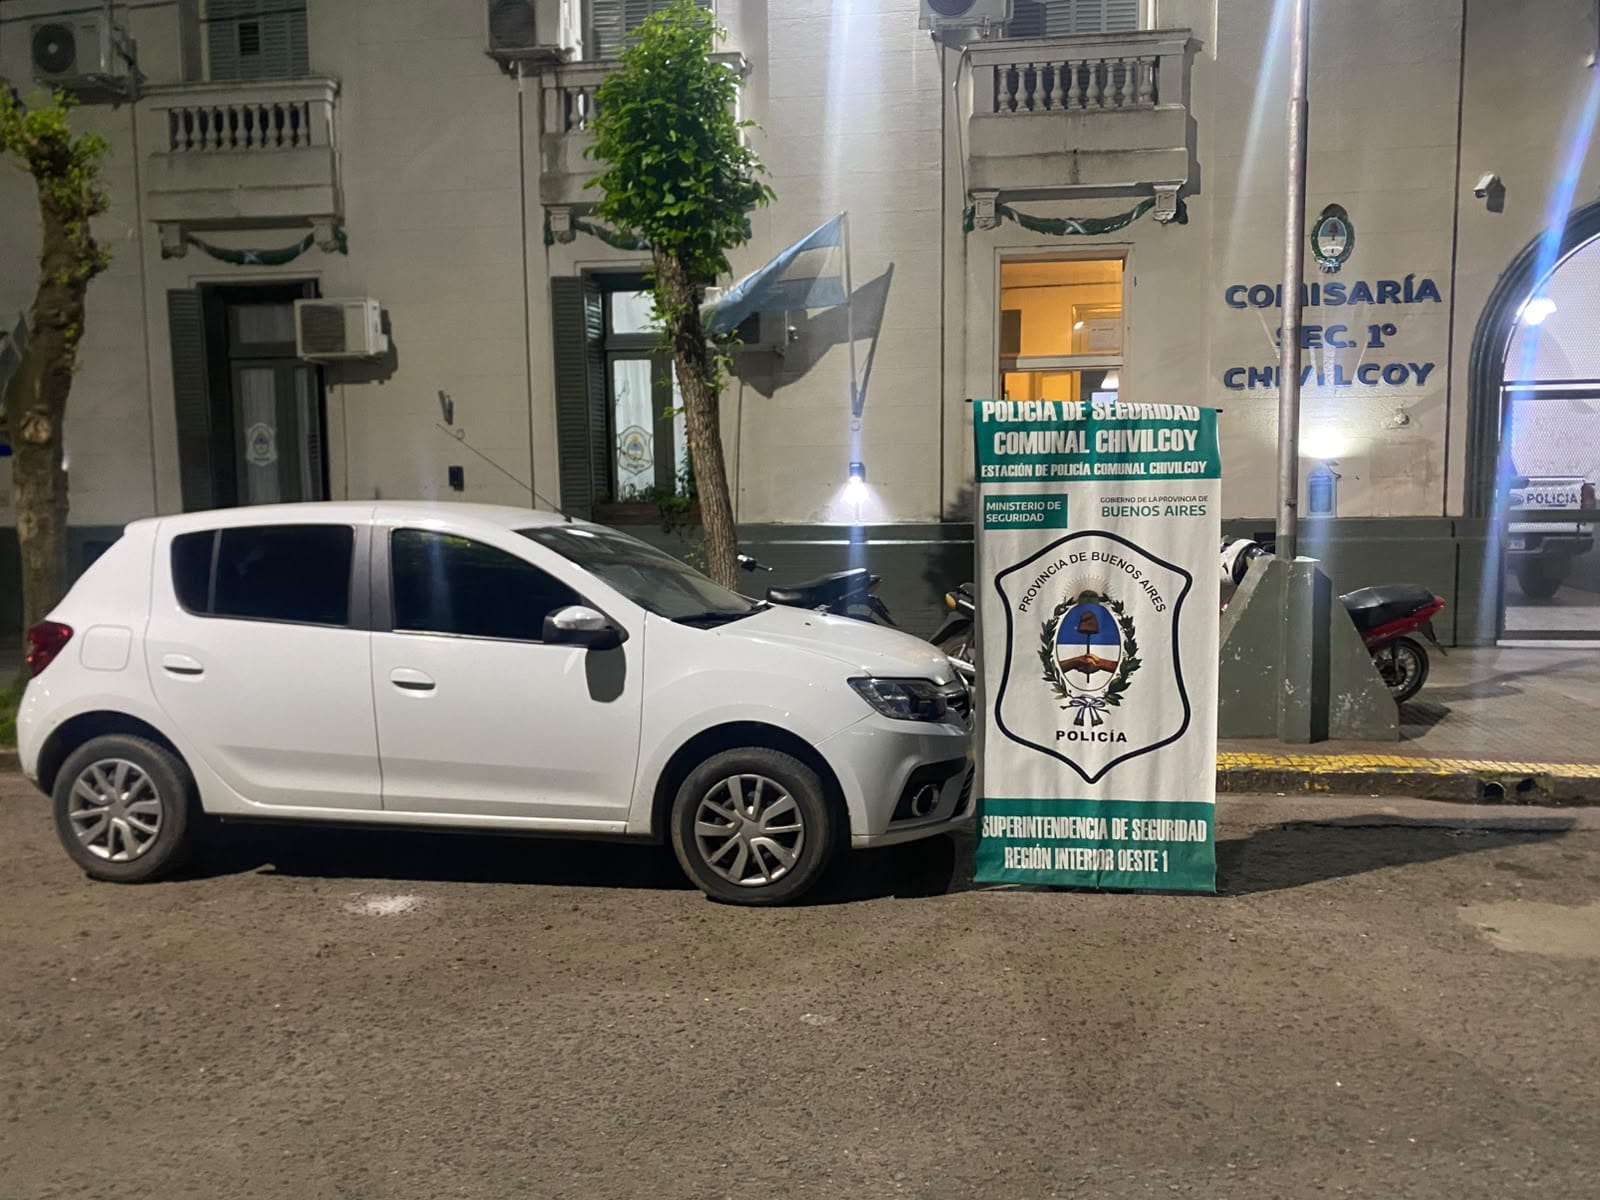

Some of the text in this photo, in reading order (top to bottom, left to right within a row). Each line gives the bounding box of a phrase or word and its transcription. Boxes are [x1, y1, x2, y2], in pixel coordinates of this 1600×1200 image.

[1276, 324, 1357, 349] EC.
[1062, 401, 1086, 421] DE
[1091, 401, 1200, 421] SEGURIDAD
[993, 428, 1198, 455] COMUNAL CHIVILCOY
[981, 460, 1207, 478] ESTACIÓN DE POLICÍA COMUNAL CHIVILCOY
[986, 501, 1062, 511] MINISTERIO DE
[1101, 504, 1207, 517] BUENOS AIRES
[986, 513, 1045, 523] SEGURIDAD
[1018, 551, 1167, 613] PROVINCIA DE BUENOS AIRES
[1056, 729, 1127, 743] POLICÍA
[981, 815, 1208, 842] SUPERINTENDENCIA DE SEGURIDAD
[1004, 843, 1169, 873] REGIÓN INTERIOR OESTE 1
